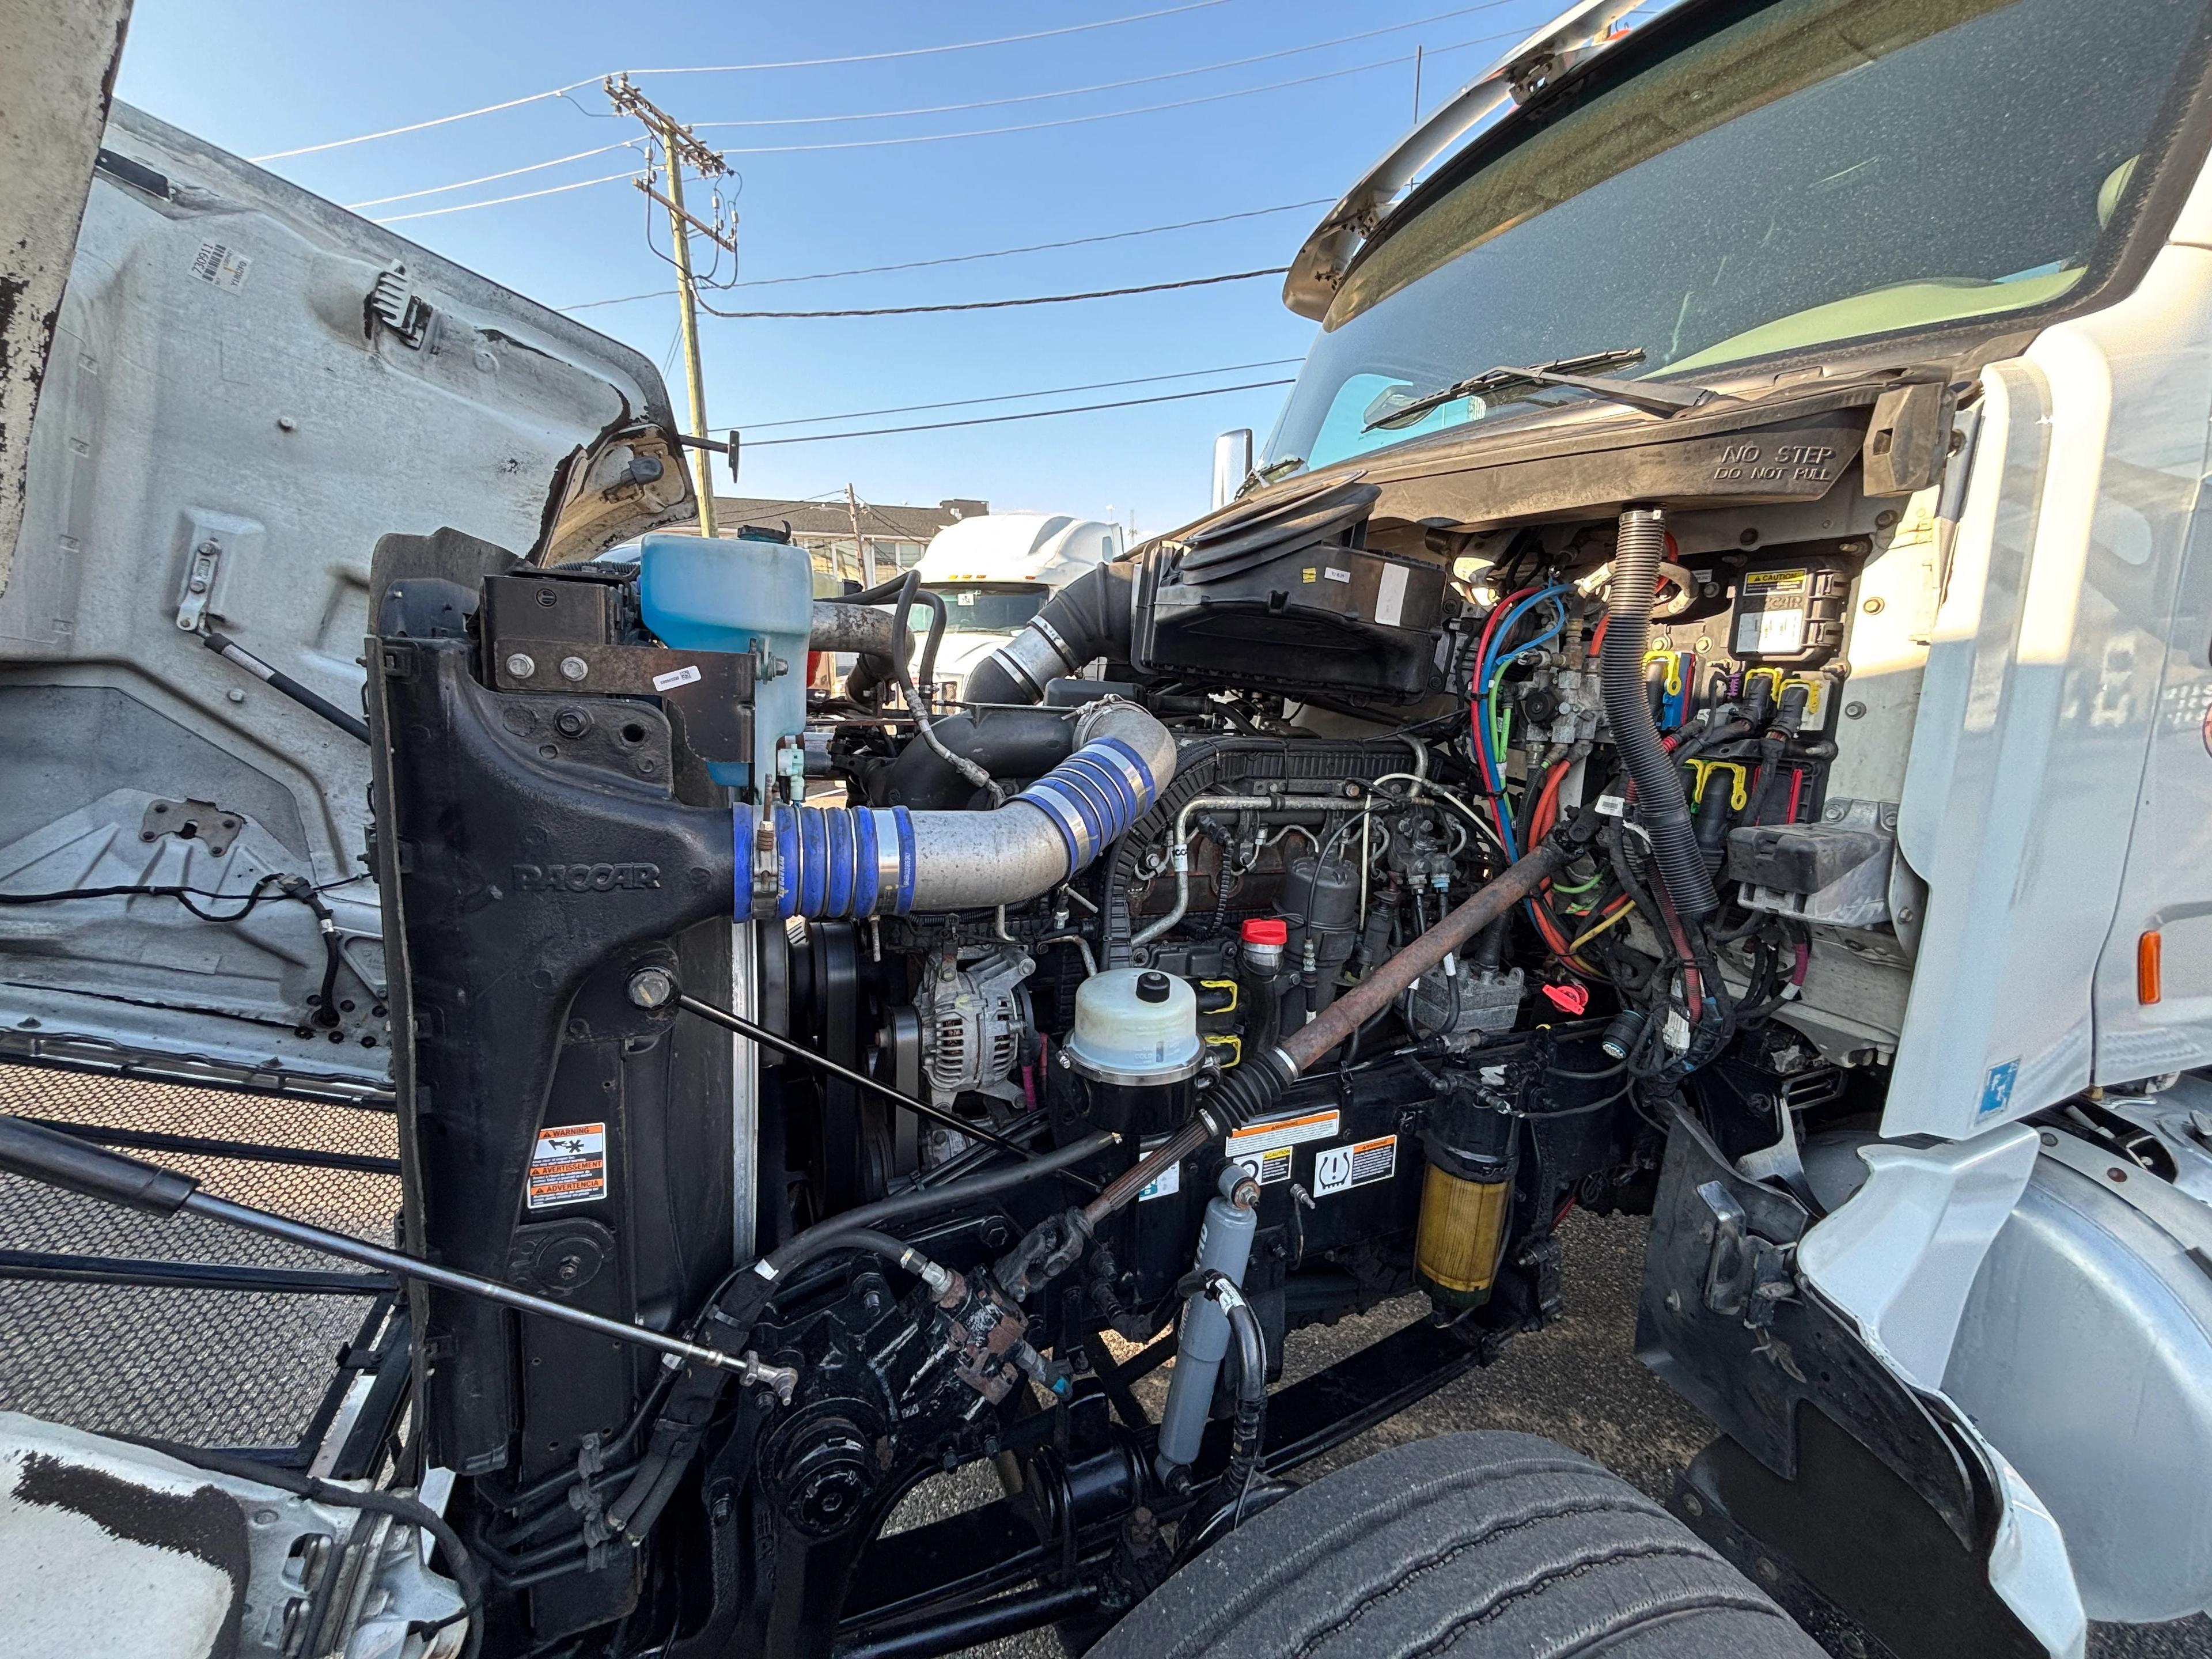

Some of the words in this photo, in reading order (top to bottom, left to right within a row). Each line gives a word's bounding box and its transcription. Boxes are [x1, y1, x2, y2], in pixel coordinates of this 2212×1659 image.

[191, 243, 213, 274] 730911
[1721, 445, 1761, 463] NO
[1775, 445, 1836, 464] STEP
[1713, 467, 1743, 480] DO
[1750, 467, 1787, 480] NOT
[1793, 467, 1832, 481] PULL
[1763, 573, 1797, 581] CAUTION
[513, 862, 661, 892] PACCAR
[553, 1127, 589, 1137] WARNING
[543, 1161, 601, 1173] AVERTISSEMENT
[547, 1180, 599, 1192] ADVERTENCIA
